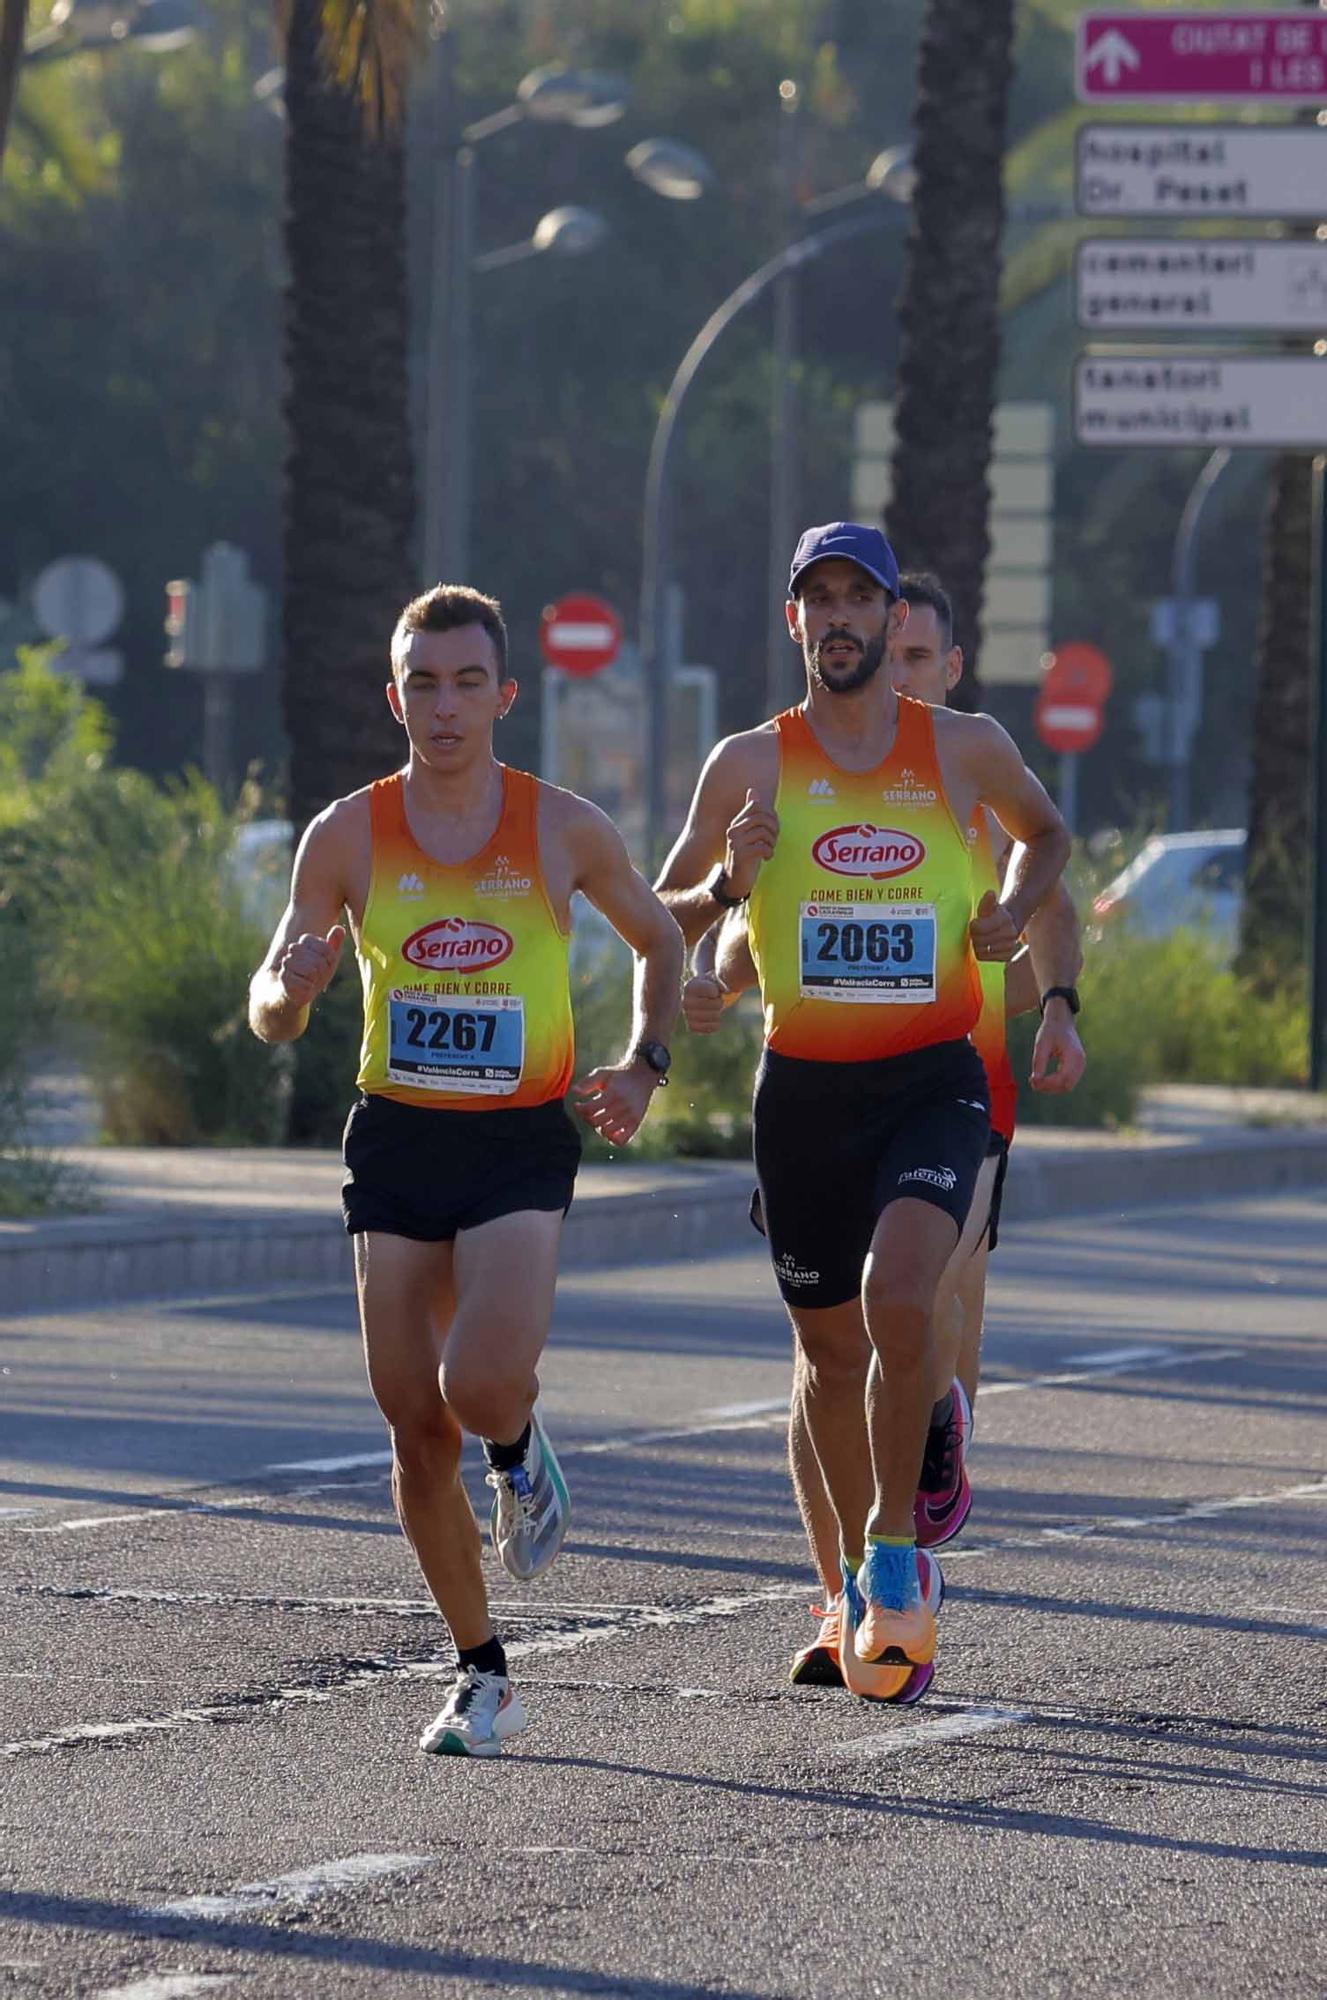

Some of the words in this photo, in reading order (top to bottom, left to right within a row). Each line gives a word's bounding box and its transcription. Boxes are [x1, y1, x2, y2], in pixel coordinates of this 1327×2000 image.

[1084, 137, 1226, 174] hospital
[1088, 288, 1211, 319] general
[1085, 367, 1222, 392] tanatori
[1084, 404, 1250, 438] municipal
[883, 790, 936, 801] SERRANO
[822, 840, 915, 863] Serrano
[811, 889, 842, 902] COME
[846, 888, 873, 901] BIEN
[877, 888, 884, 900] Y
[888, 887, 923, 900] CORRE
[414, 936, 504, 960] Serrano
[817, 923, 913, 962] 2063
[433, 983, 460, 994] BIEN
[463, 982, 471, 994] Y
[474, 982, 512, 995] CORRE
[406, 1008, 498, 1052] 2267
